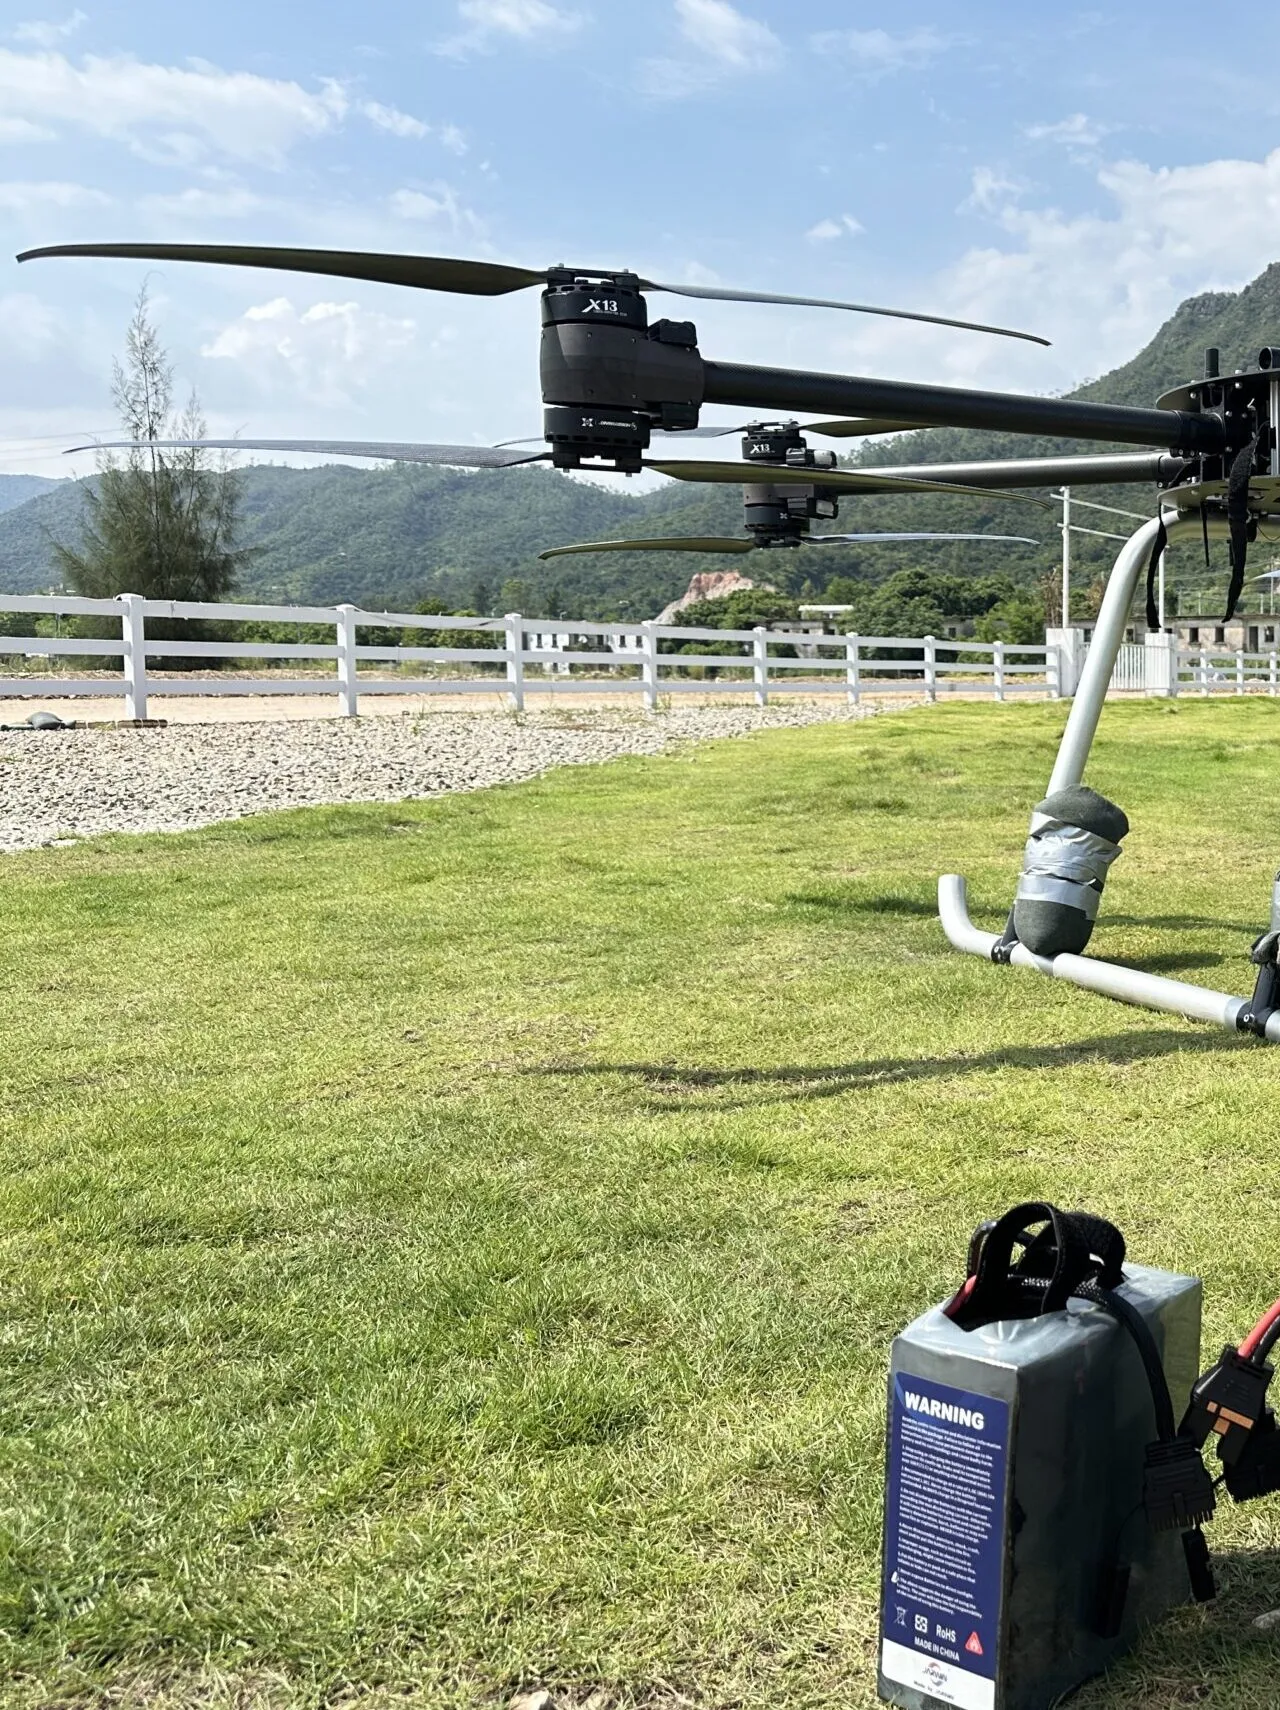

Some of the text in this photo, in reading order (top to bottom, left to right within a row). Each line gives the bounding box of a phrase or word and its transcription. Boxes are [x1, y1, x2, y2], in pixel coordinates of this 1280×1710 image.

[581, 298, 618, 313] X13
[904, 1391, 984, 1430] WARNING
[936, 1622, 957, 1644] RoHS
[914, 1636, 960, 1662] MADE IN CHINA
